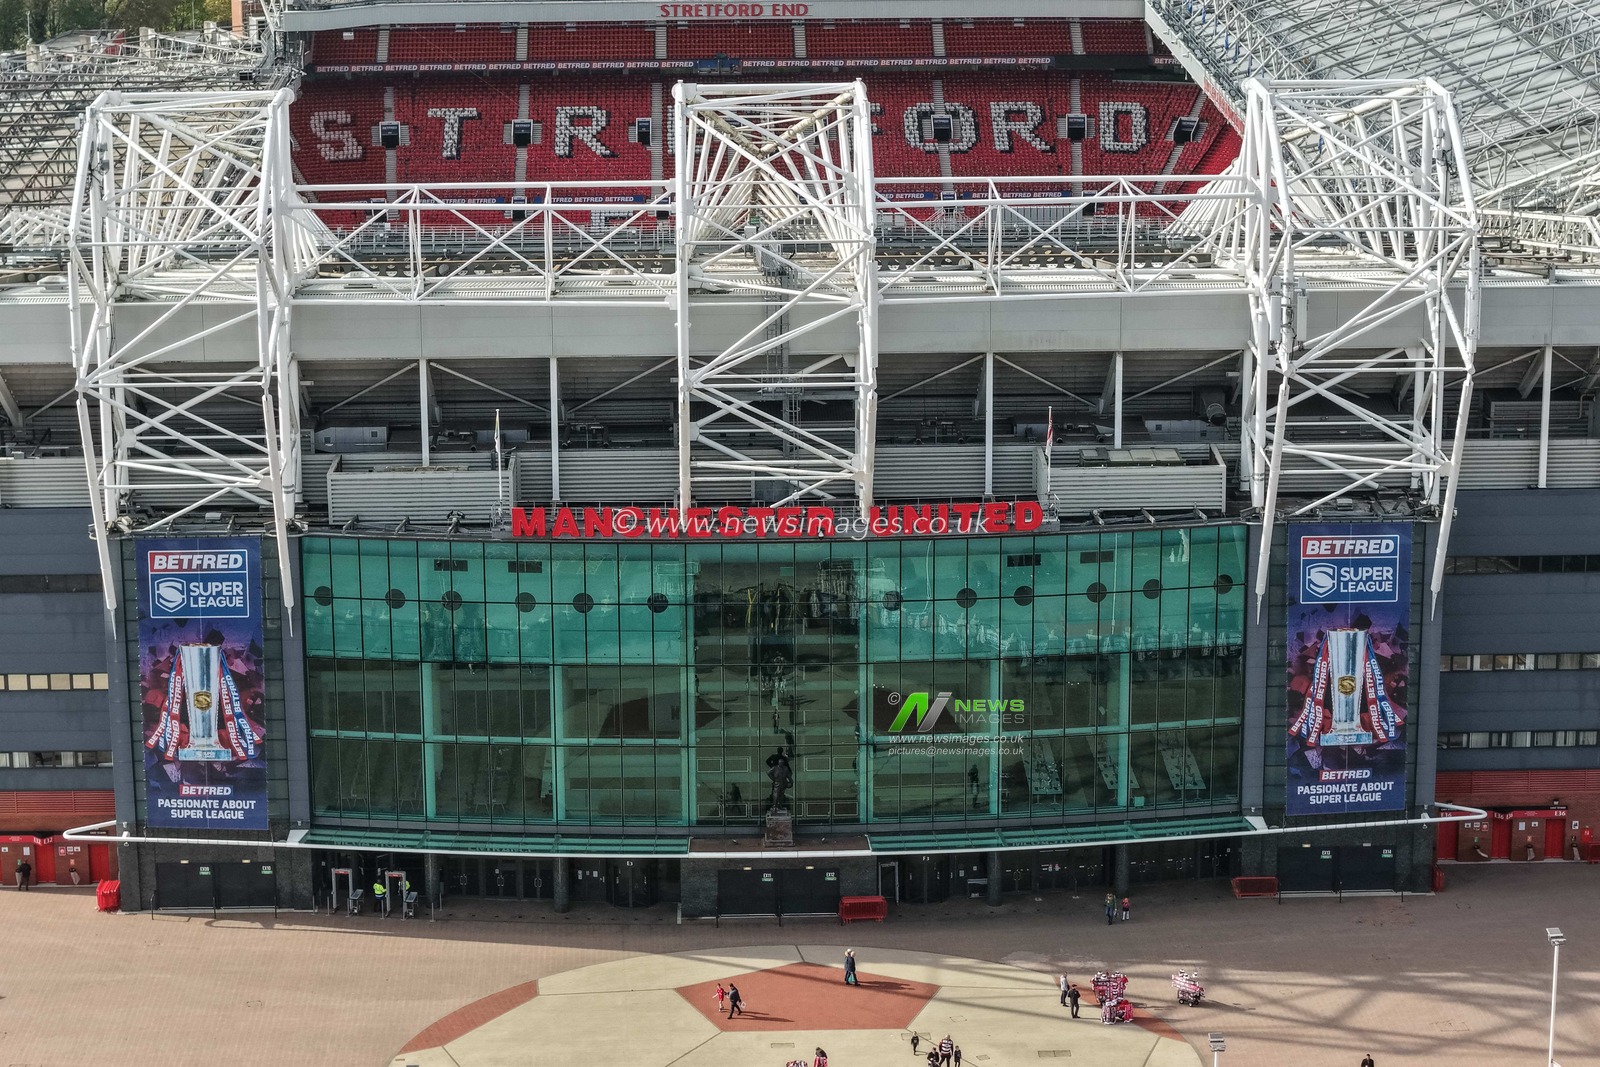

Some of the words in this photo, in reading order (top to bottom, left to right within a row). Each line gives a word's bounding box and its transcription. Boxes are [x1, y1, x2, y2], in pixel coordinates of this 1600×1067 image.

[660, 4, 764, 17] STRETFORD
[772, 4, 808, 16] END
[512, 506, 834, 538] MANCHESTER
[870, 501, 1043, 536] UNITED
[154, 554, 243, 570] BETFRED
[1306, 539, 1394, 555] BETFRED
[189, 582, 243, 596] SUPER
[1340, 567, 1393, 580] SUPER
[1340, 581, 1393, 592] LEAGUE
[190, 597, 244, 607] LEAGUE
[172, 676, 181, 714] BETFRED
[225, 674, 241, 712] BETFRED
[1316, 661, 1327, 700] BETFRED
[1366, 661, 1375, 698] BETFRED
[1371, 659, 1385, 696] BETFRED
[148, 711, 168, 746] BETFRED
[1291, 697, 1311, 732] BETFRED
[1308, 705, 1322, 743] BETFRED
[1370, 704, 1386, 739] BETFRED
[1381, 701, 1395, 737] BETFRED
[166, 720, 180, 757] BETFRED
[227, 721, 246, 756] BETFRED
[239, 718, 254, 755] BETFRED
[182, 786, 232, 796] BETFRED
[1297, 784, 1358, 794] PASSIONATE
[1360, 782, 1394, 792] ABOUT
[1322, 770, 1370, 780] BETFRED
[158, 799, 219, 809] PASSIONATE
[222, 800, 256, 809] ABOUT
[171, 810, 203, 818] SUPER
[206, 810, 244, 819] LEAGUE
[1310, 795, 1341, 804] SUPER
[1344, 793, 1382, 803] LEAGUE
